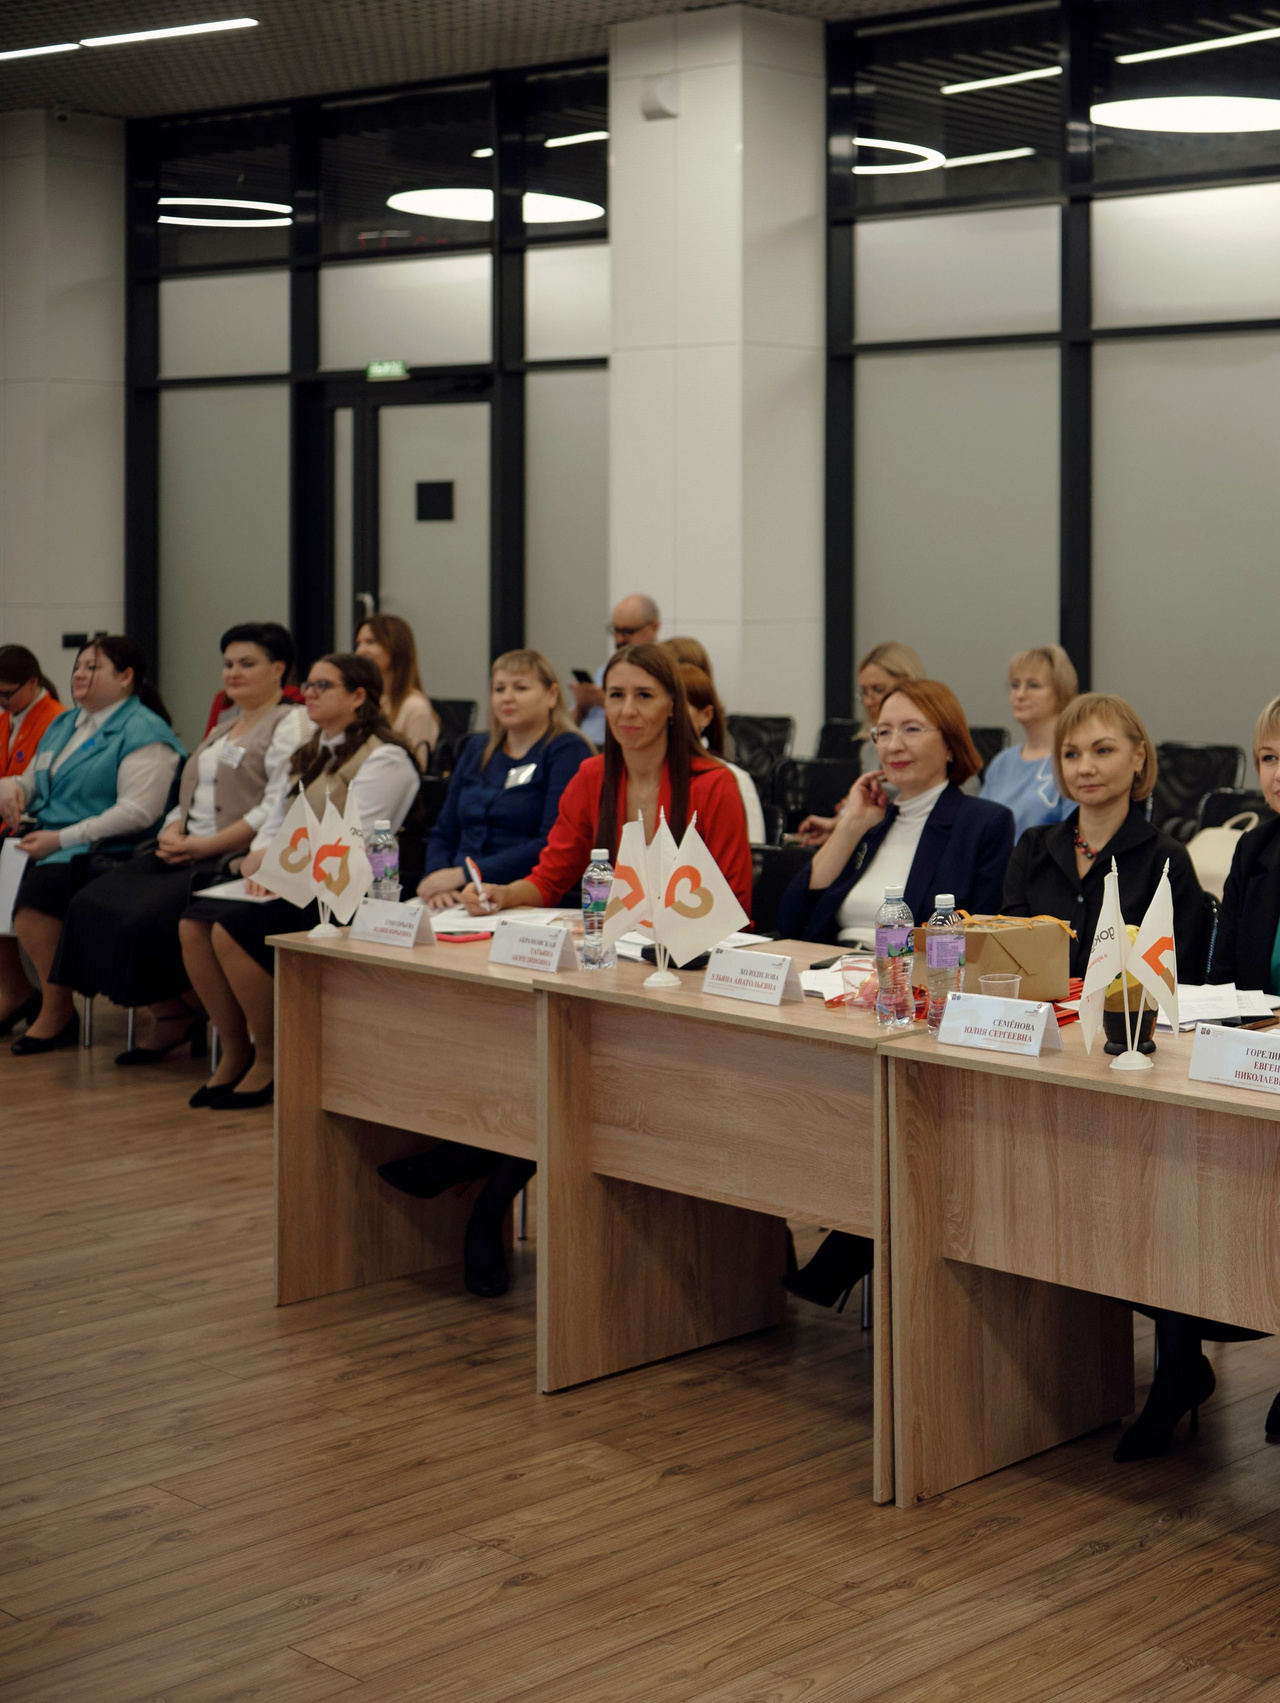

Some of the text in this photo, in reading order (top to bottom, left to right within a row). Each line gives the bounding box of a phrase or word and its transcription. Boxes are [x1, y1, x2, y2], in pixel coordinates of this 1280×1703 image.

[711, 973, 733, 983] УЛЬЯНА
[734, 978, 777, 991] АНАТОЛЬЕВНА
[992, 1018, 1035, 1031] СЕМЁНОВА
[964, 1026, 987, 1036] ЮЛИЯ
[988, 1029, 1032, 1042] СЕРГЕЕВНА
